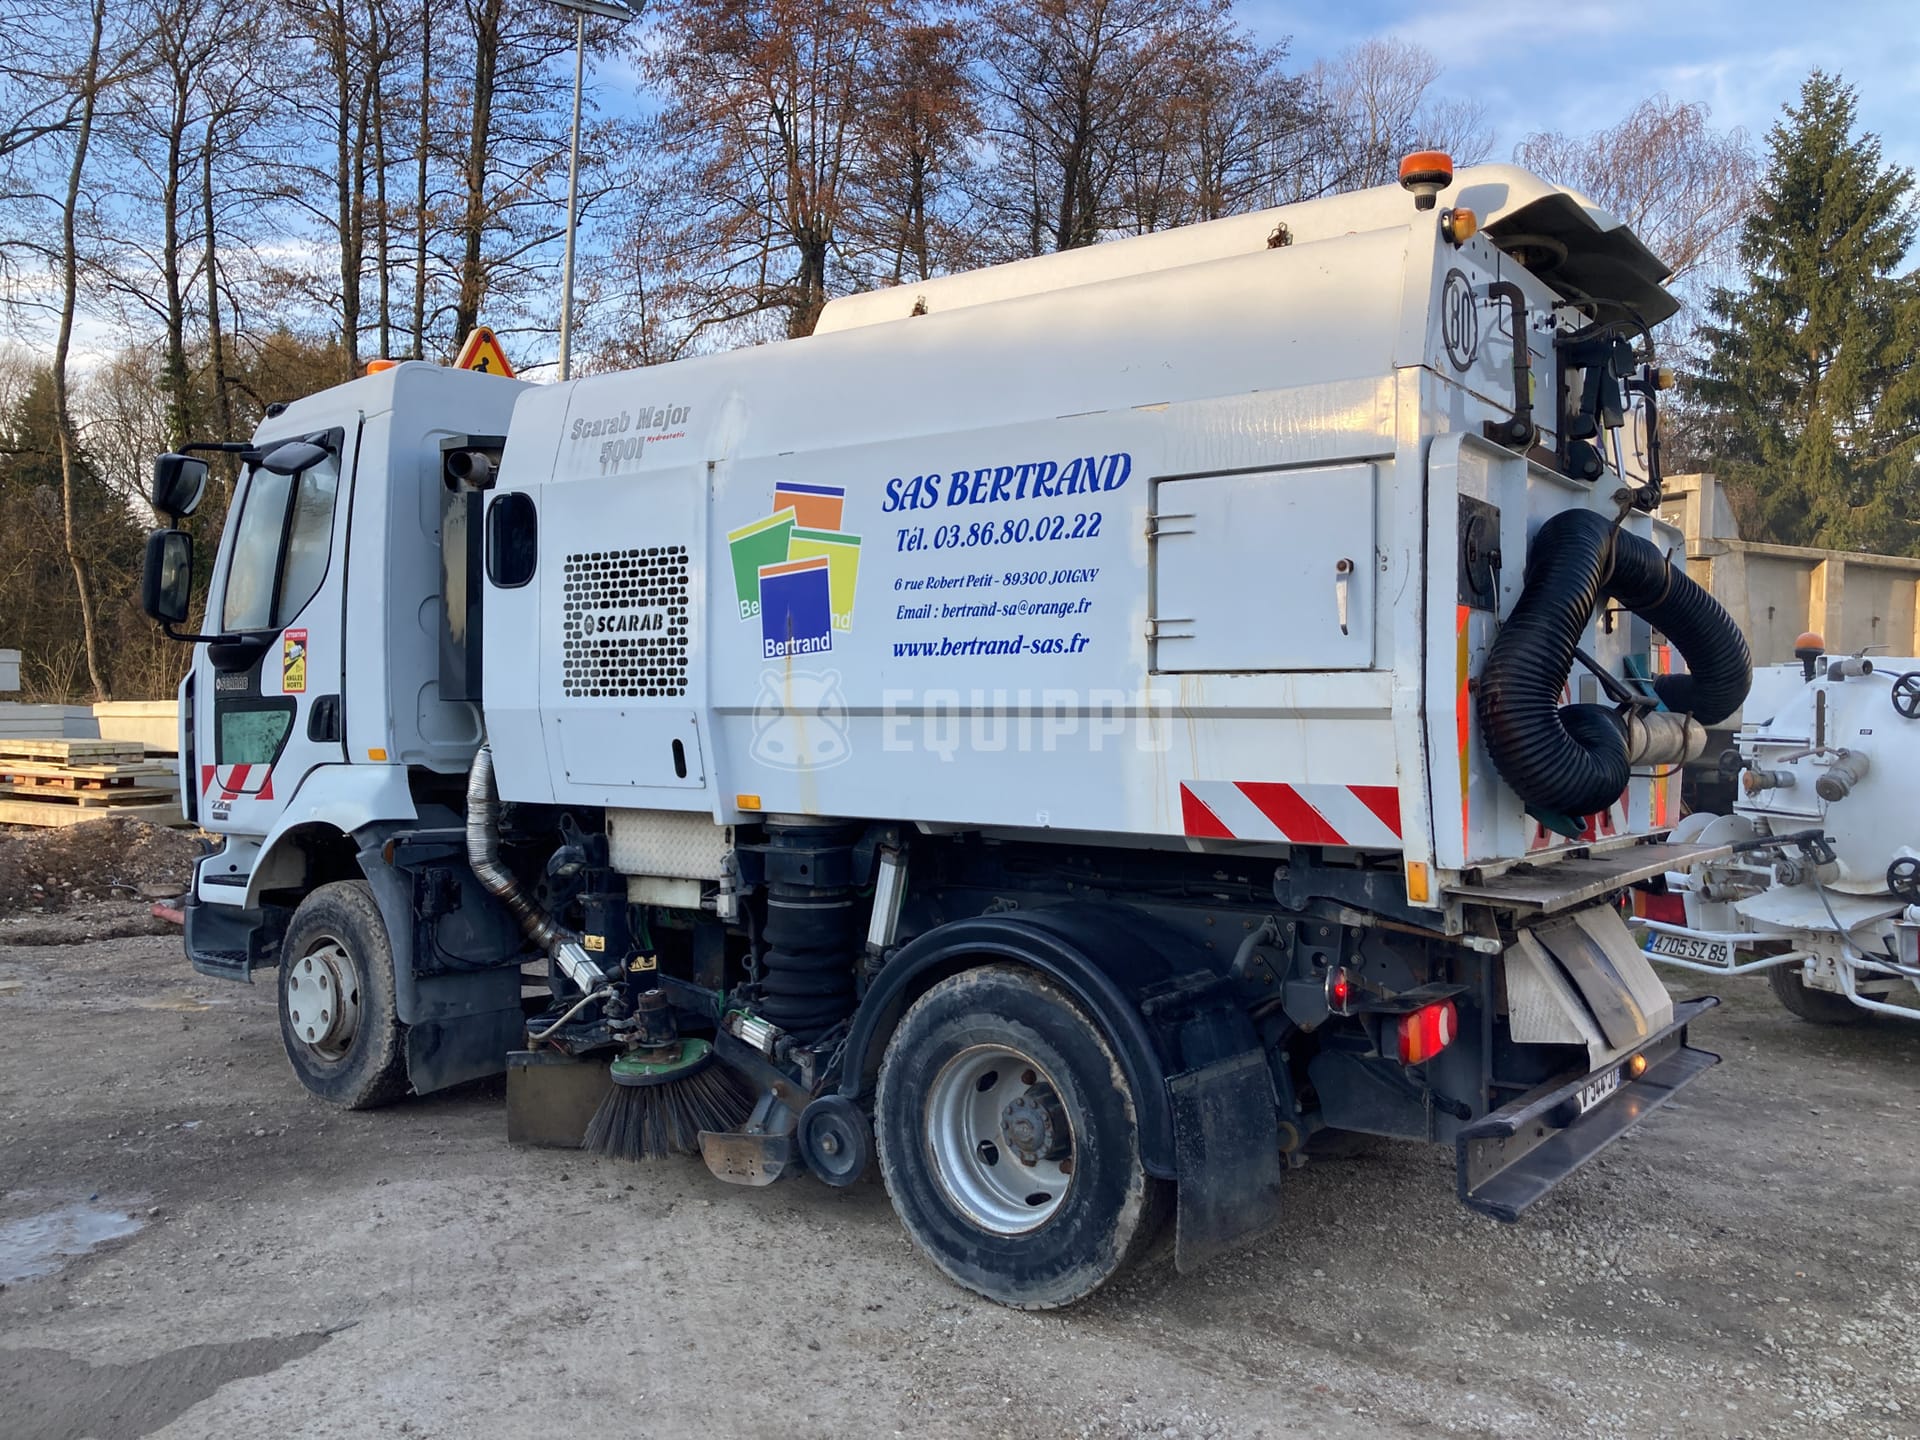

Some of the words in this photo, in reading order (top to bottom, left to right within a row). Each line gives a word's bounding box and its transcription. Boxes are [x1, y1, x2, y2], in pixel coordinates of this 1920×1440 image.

[1450, 283, 1471, 356] 80
[571, 410, 631, 440] Scarab
[636, 403, 691, 432] Major
[882, 473, 942, 513] SAS
[946, 452, 1132, 507] BERTRAND
[896, 526, 929, 553] Tél.
[933, 511, 1102, 549] 03.86.80.02.22
[894, 577, 902, 591] 6
[904, 580, 924, 591] rue
[926, 575, 965, 590] Robert
[966, 573, 993, 588] Petit
[1002, 571, 1048, 587] 89300
[1048, 567, 1100, 586] JOIGNY
[896, 603, 932, 620] Email
[941, 597, 1092, 619] bertrand-sa@orange.fr
[596, 613, 664, 633] SCARAB
[764, 630, 831, 657] Bertrand
[892, 632, 1090, 658] www.bertrand-sas.fr
[1654, 936, 1688, 955] 4705
[1689, 940, 1708, 959] SZ
[1708, 944, 1728, 962] 89
